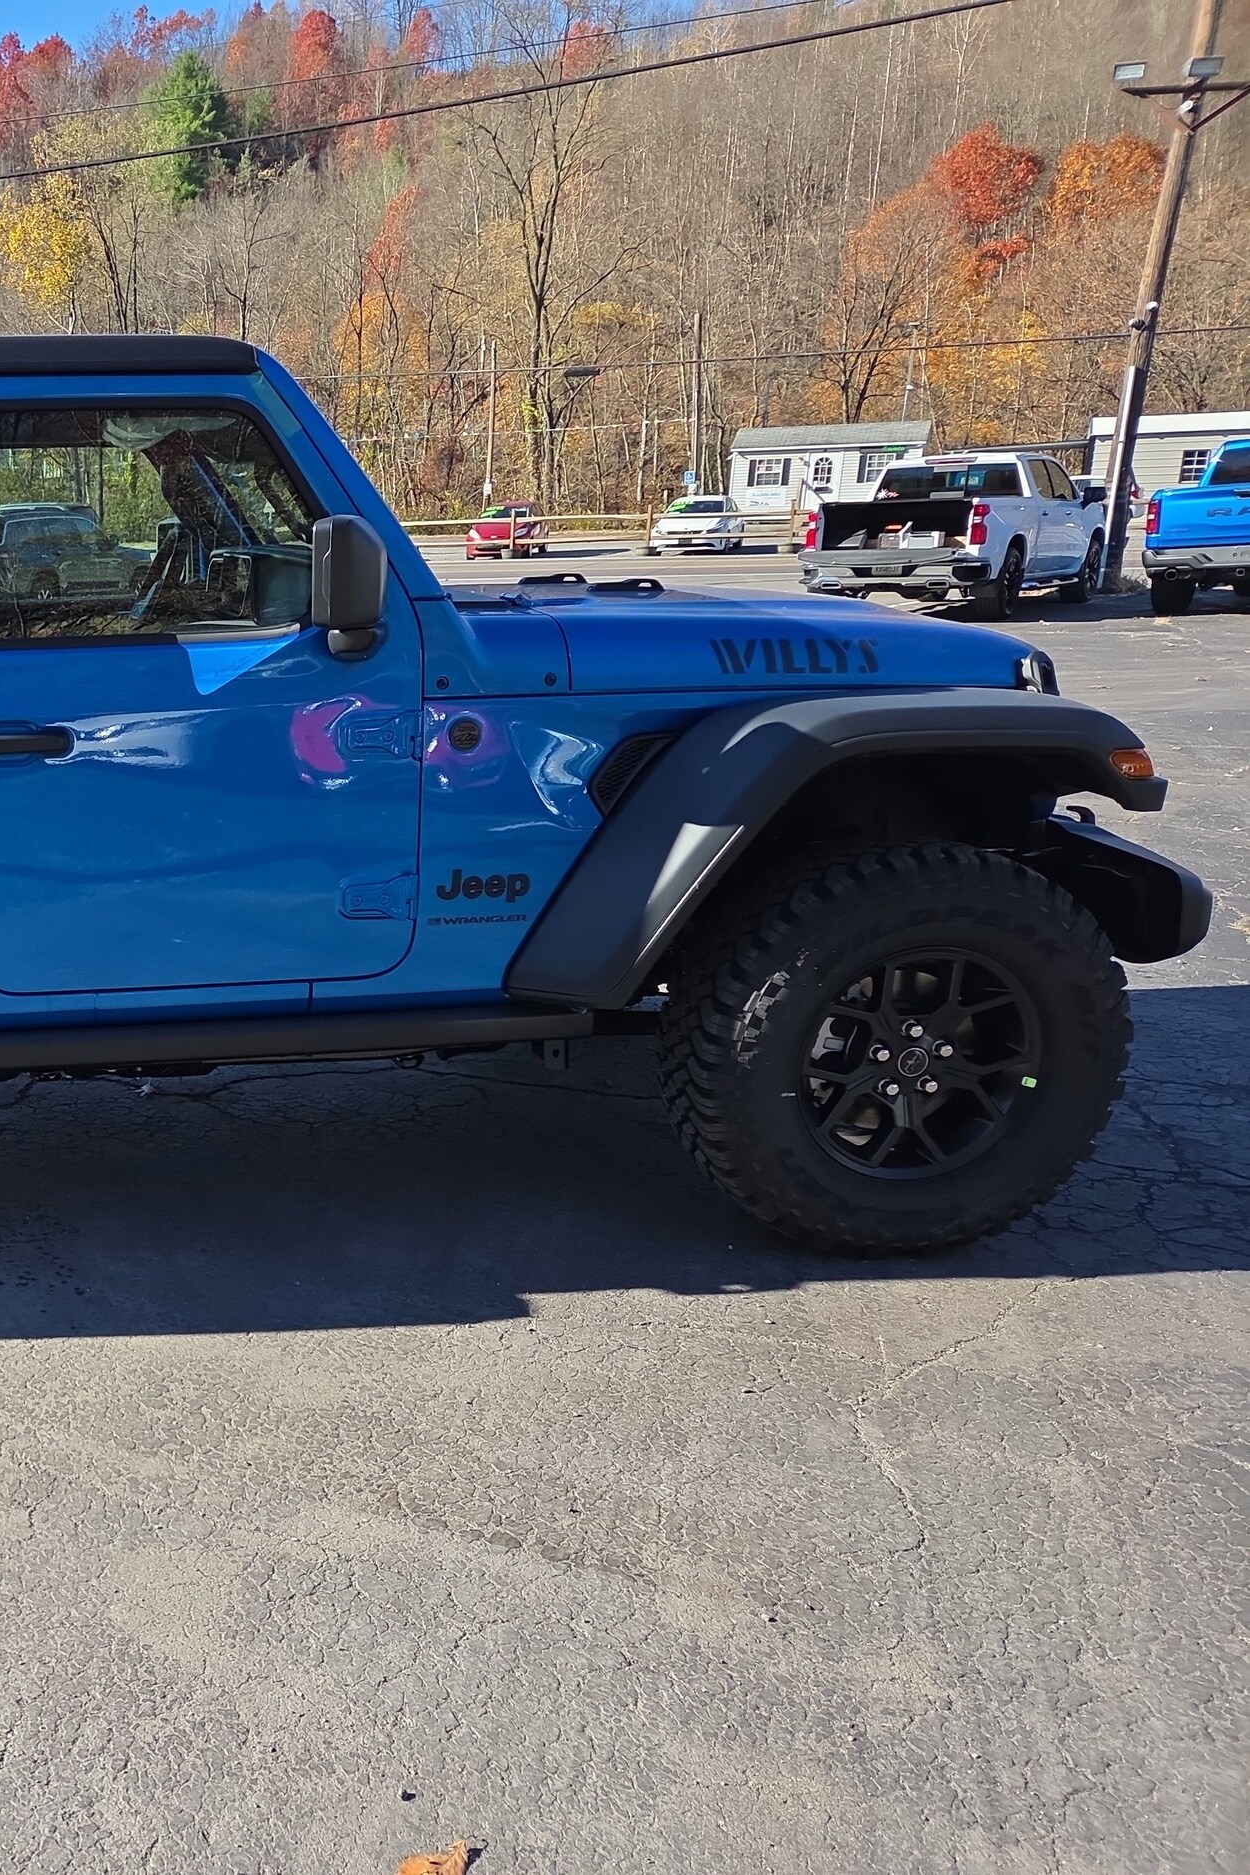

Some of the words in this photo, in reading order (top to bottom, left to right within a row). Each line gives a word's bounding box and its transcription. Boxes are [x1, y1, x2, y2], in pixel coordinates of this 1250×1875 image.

[708, 638, 880, 675] WILLYS
[436, 868, 530, 903] Jeep
[442, 914, 527, 925] WRANGLER
